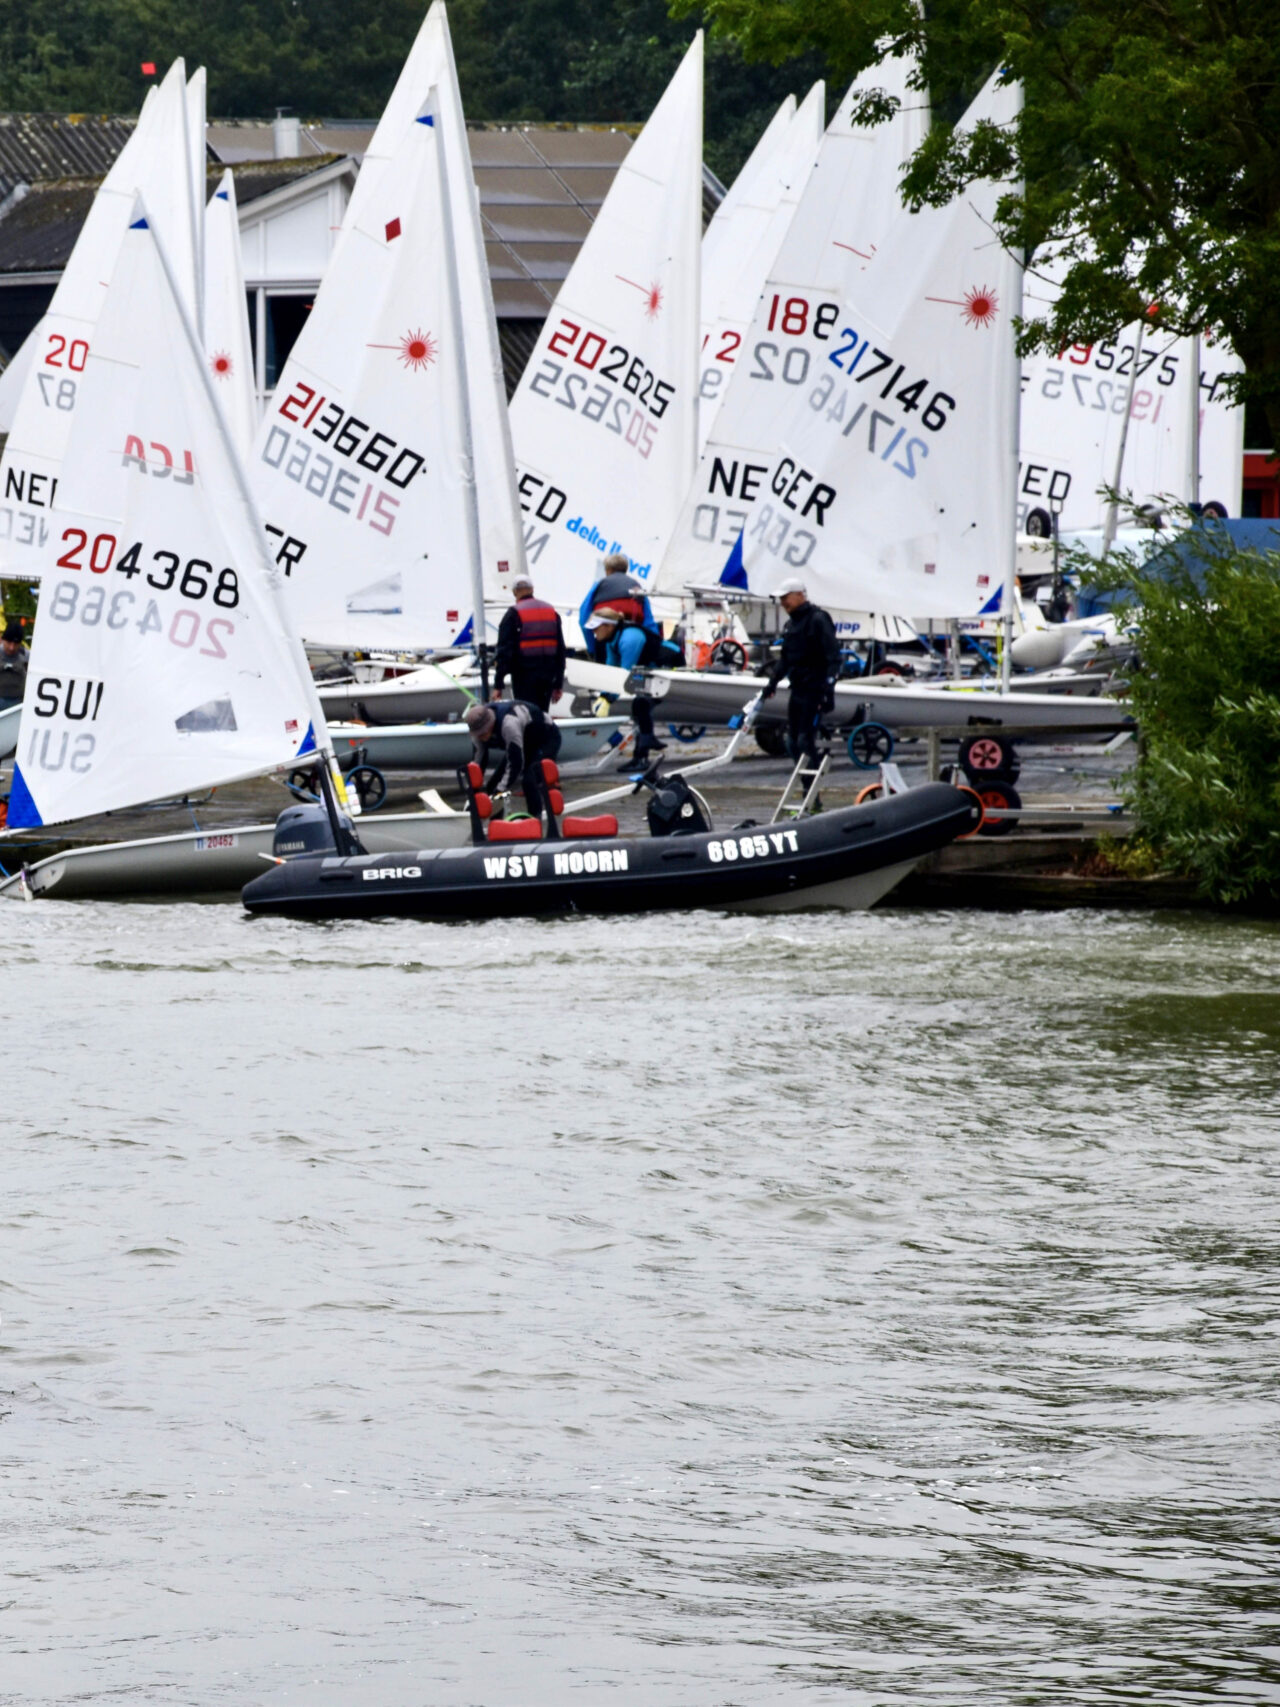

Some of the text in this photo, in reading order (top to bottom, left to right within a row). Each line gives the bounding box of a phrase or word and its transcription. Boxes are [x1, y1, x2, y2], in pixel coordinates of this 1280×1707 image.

[45, 334, 89, 372] 20
[547, 318, 676, 419] 202625
[828, 327, 956, 432] 217146
[278, 381, 425, 489] 213660
[771, 457, 837, 527] GER
[566, 517, 608, 552] delta
[56, 528, 240, 609] 204368
[34, 677, 104, 721] SUI
[362, 867, 422, 881] BRIG
[484, 848, 629, 879] WSV HOORN
